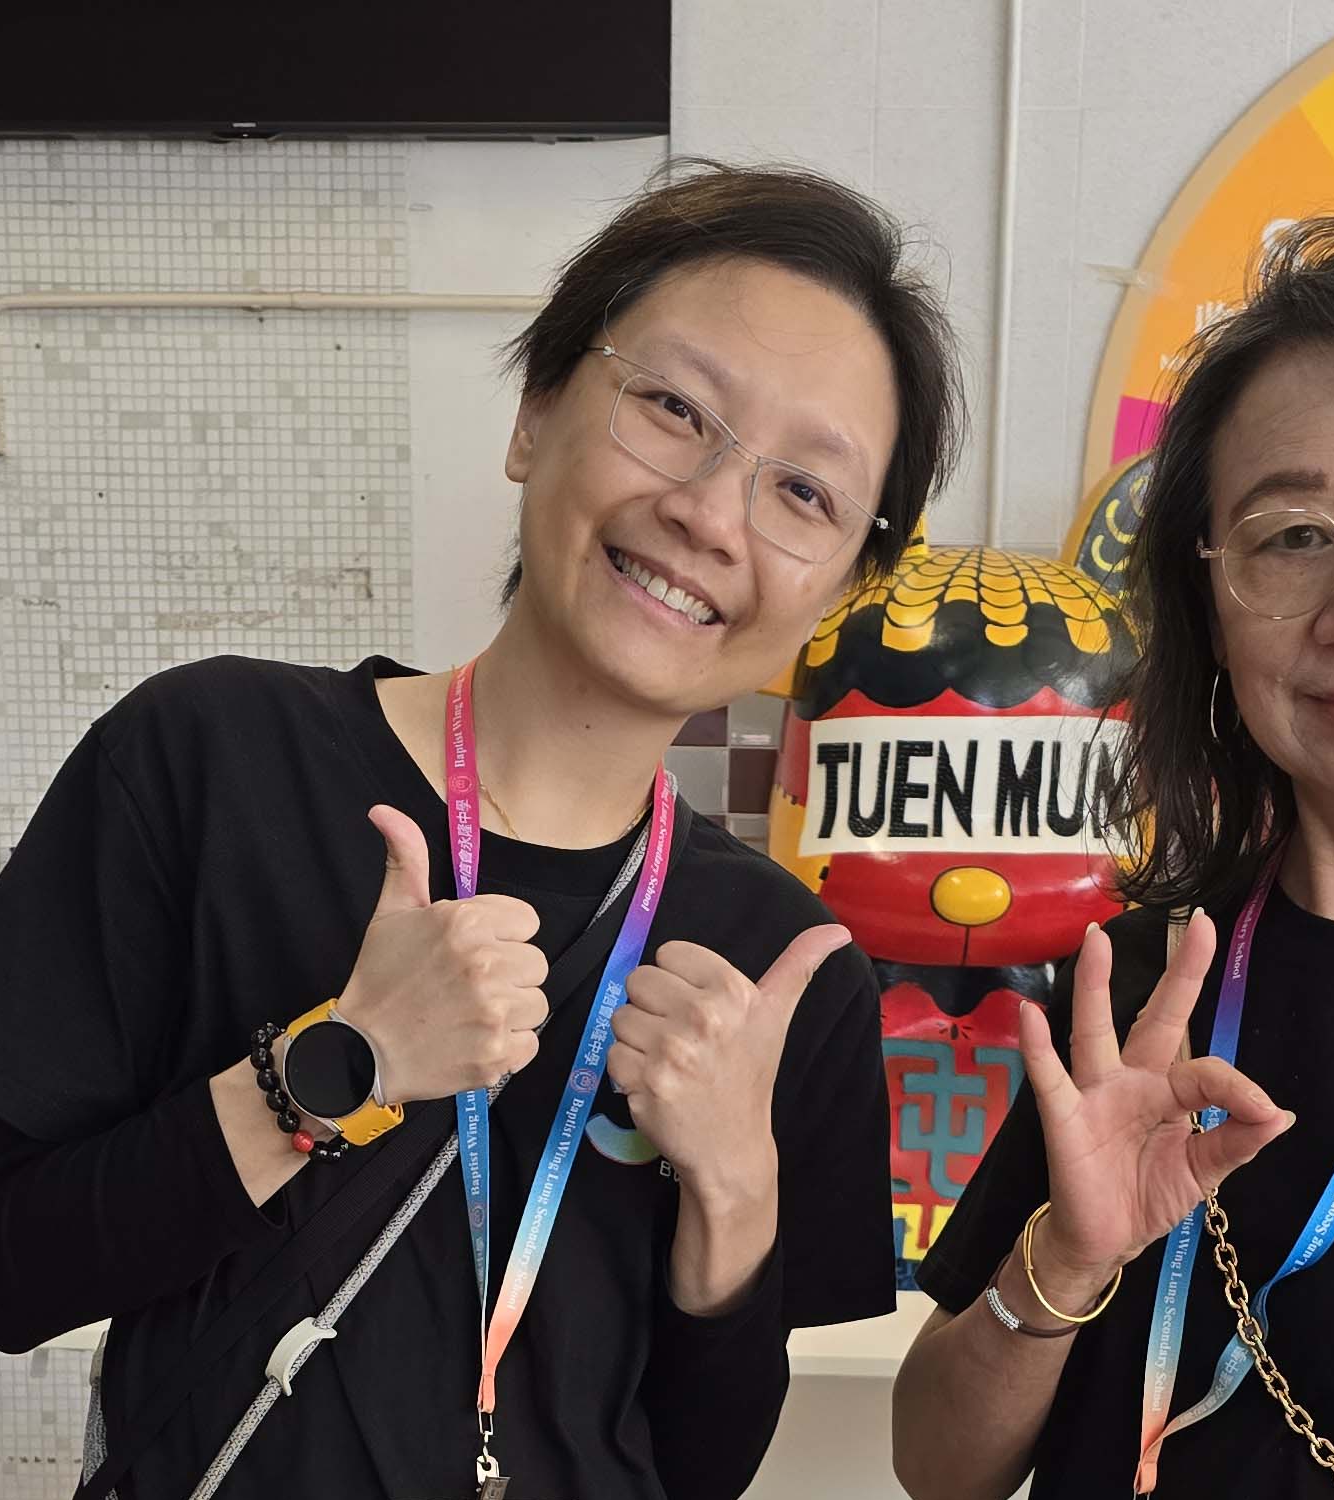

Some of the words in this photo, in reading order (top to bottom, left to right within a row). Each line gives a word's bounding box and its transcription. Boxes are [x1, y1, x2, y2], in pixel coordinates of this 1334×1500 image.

[453, 734, 467, 768] Baptist
[817, 740, 978, 839] TUEN
[996, 739, 1130, 838] MUN
[641, 876, 661, 912] School
[467, 1110, 479, 1148] Wing
[560, 1097, 584, 1137] Baptist
[469, 1151, 481, 1196] Baptist
[549, 1136, 570, 1173] Wing
[540, 1167, 559, 1201] Lung
[518, 1199, 549, 1267] Secondary
[1170, 1234, 1190, 1272] Wing
[1298, 1241, 1320, 1272] Lung
[1164, 1268, 1184, 1304] Lung
[1156, 1300, 1177, 1371] Secondary
[1151, 1366, 1167, 1413] School
